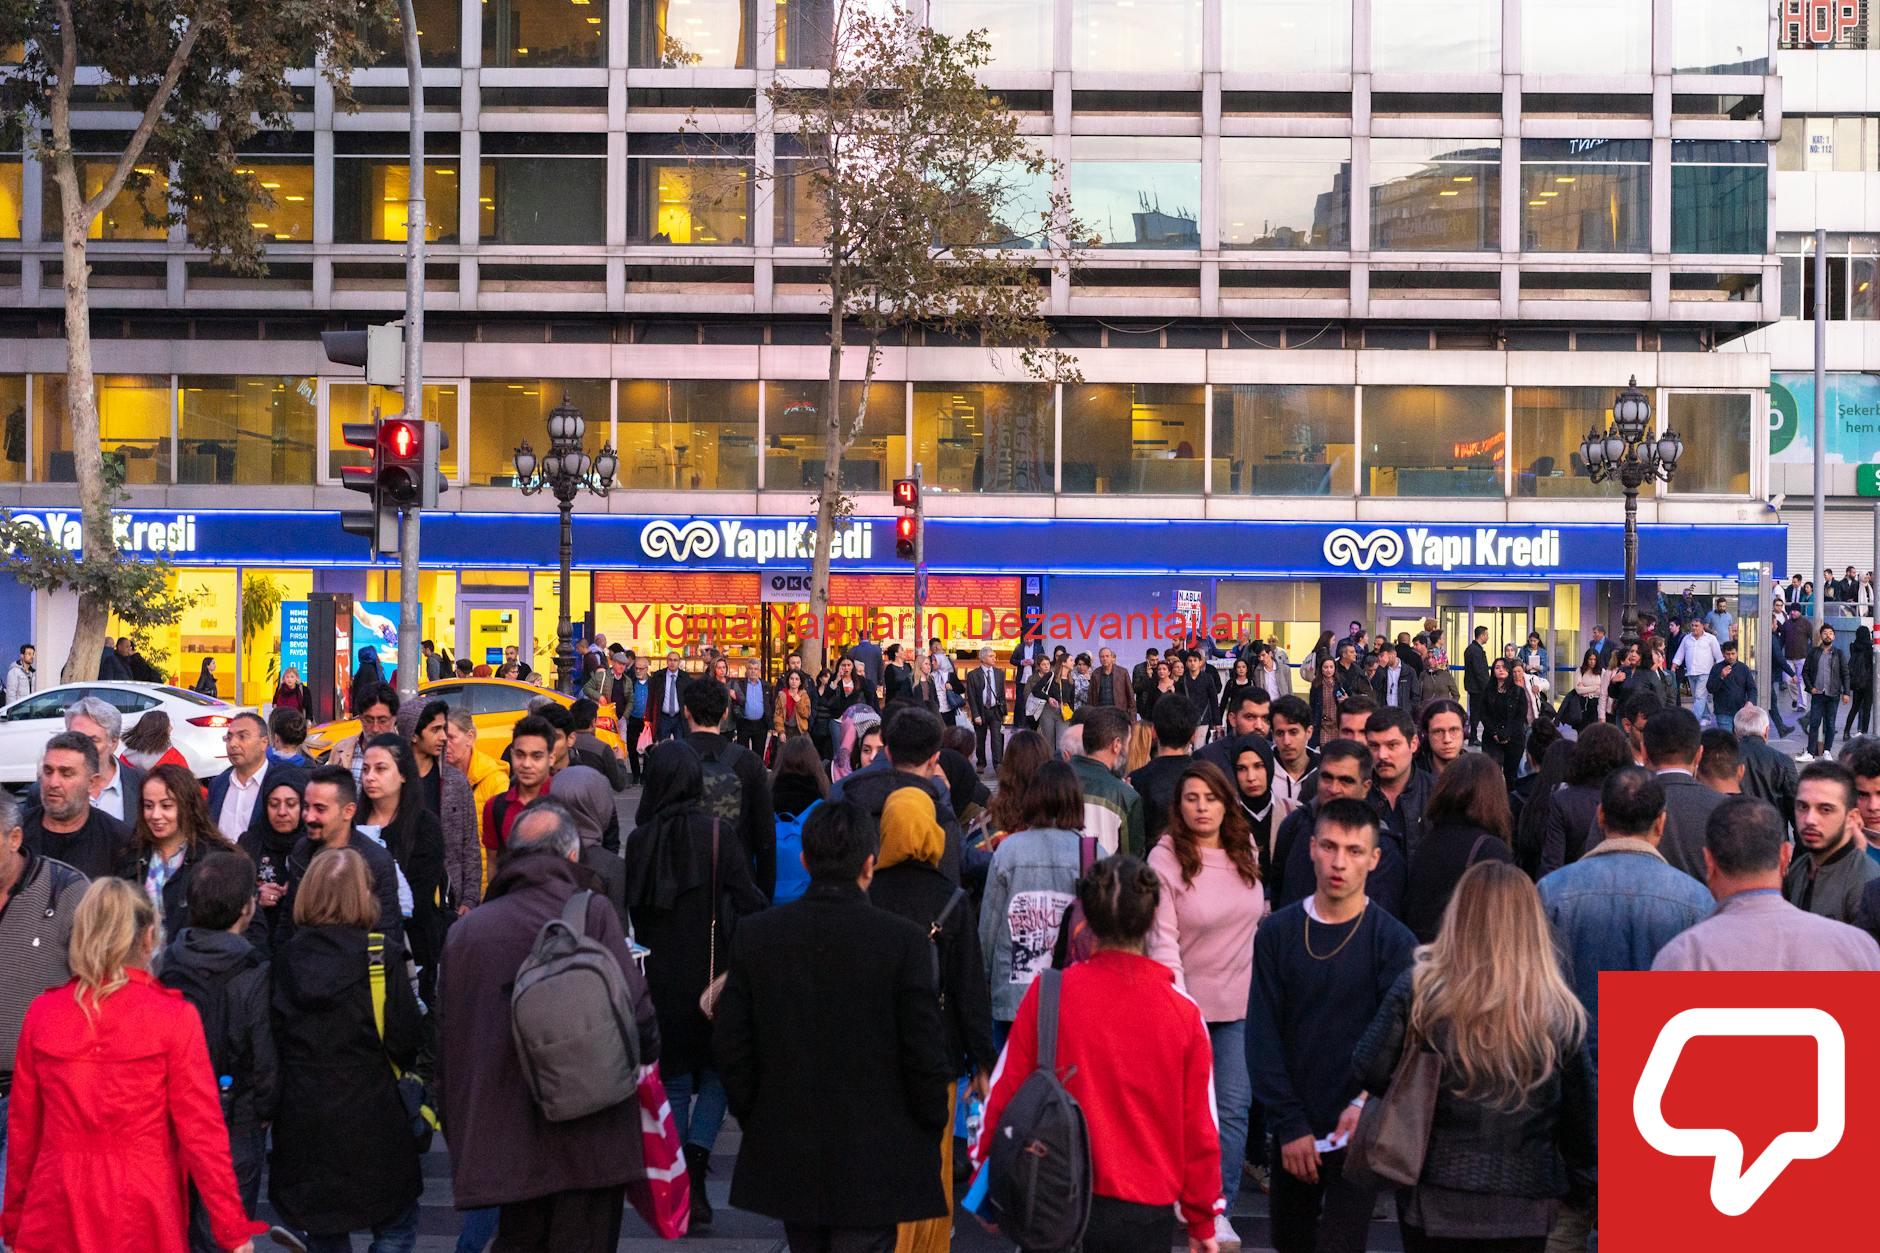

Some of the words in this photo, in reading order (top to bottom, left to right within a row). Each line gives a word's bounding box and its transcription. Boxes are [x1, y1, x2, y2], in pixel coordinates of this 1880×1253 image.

[1776, 0, 1859, 43] HOP
[1846, 421, 1874, 433] hem
[901, 484, 911, 501] 4
[46, 512, 82, 550] Ya
[112, 513, 196, 552] Kredi
[1406, 528, 1471, 571] Yapı
[1475, 528, 1560, 567] Kredi
[1762, 566, 1771, 576] 2
[1178, 591, 1201, 602] N.ABLA
